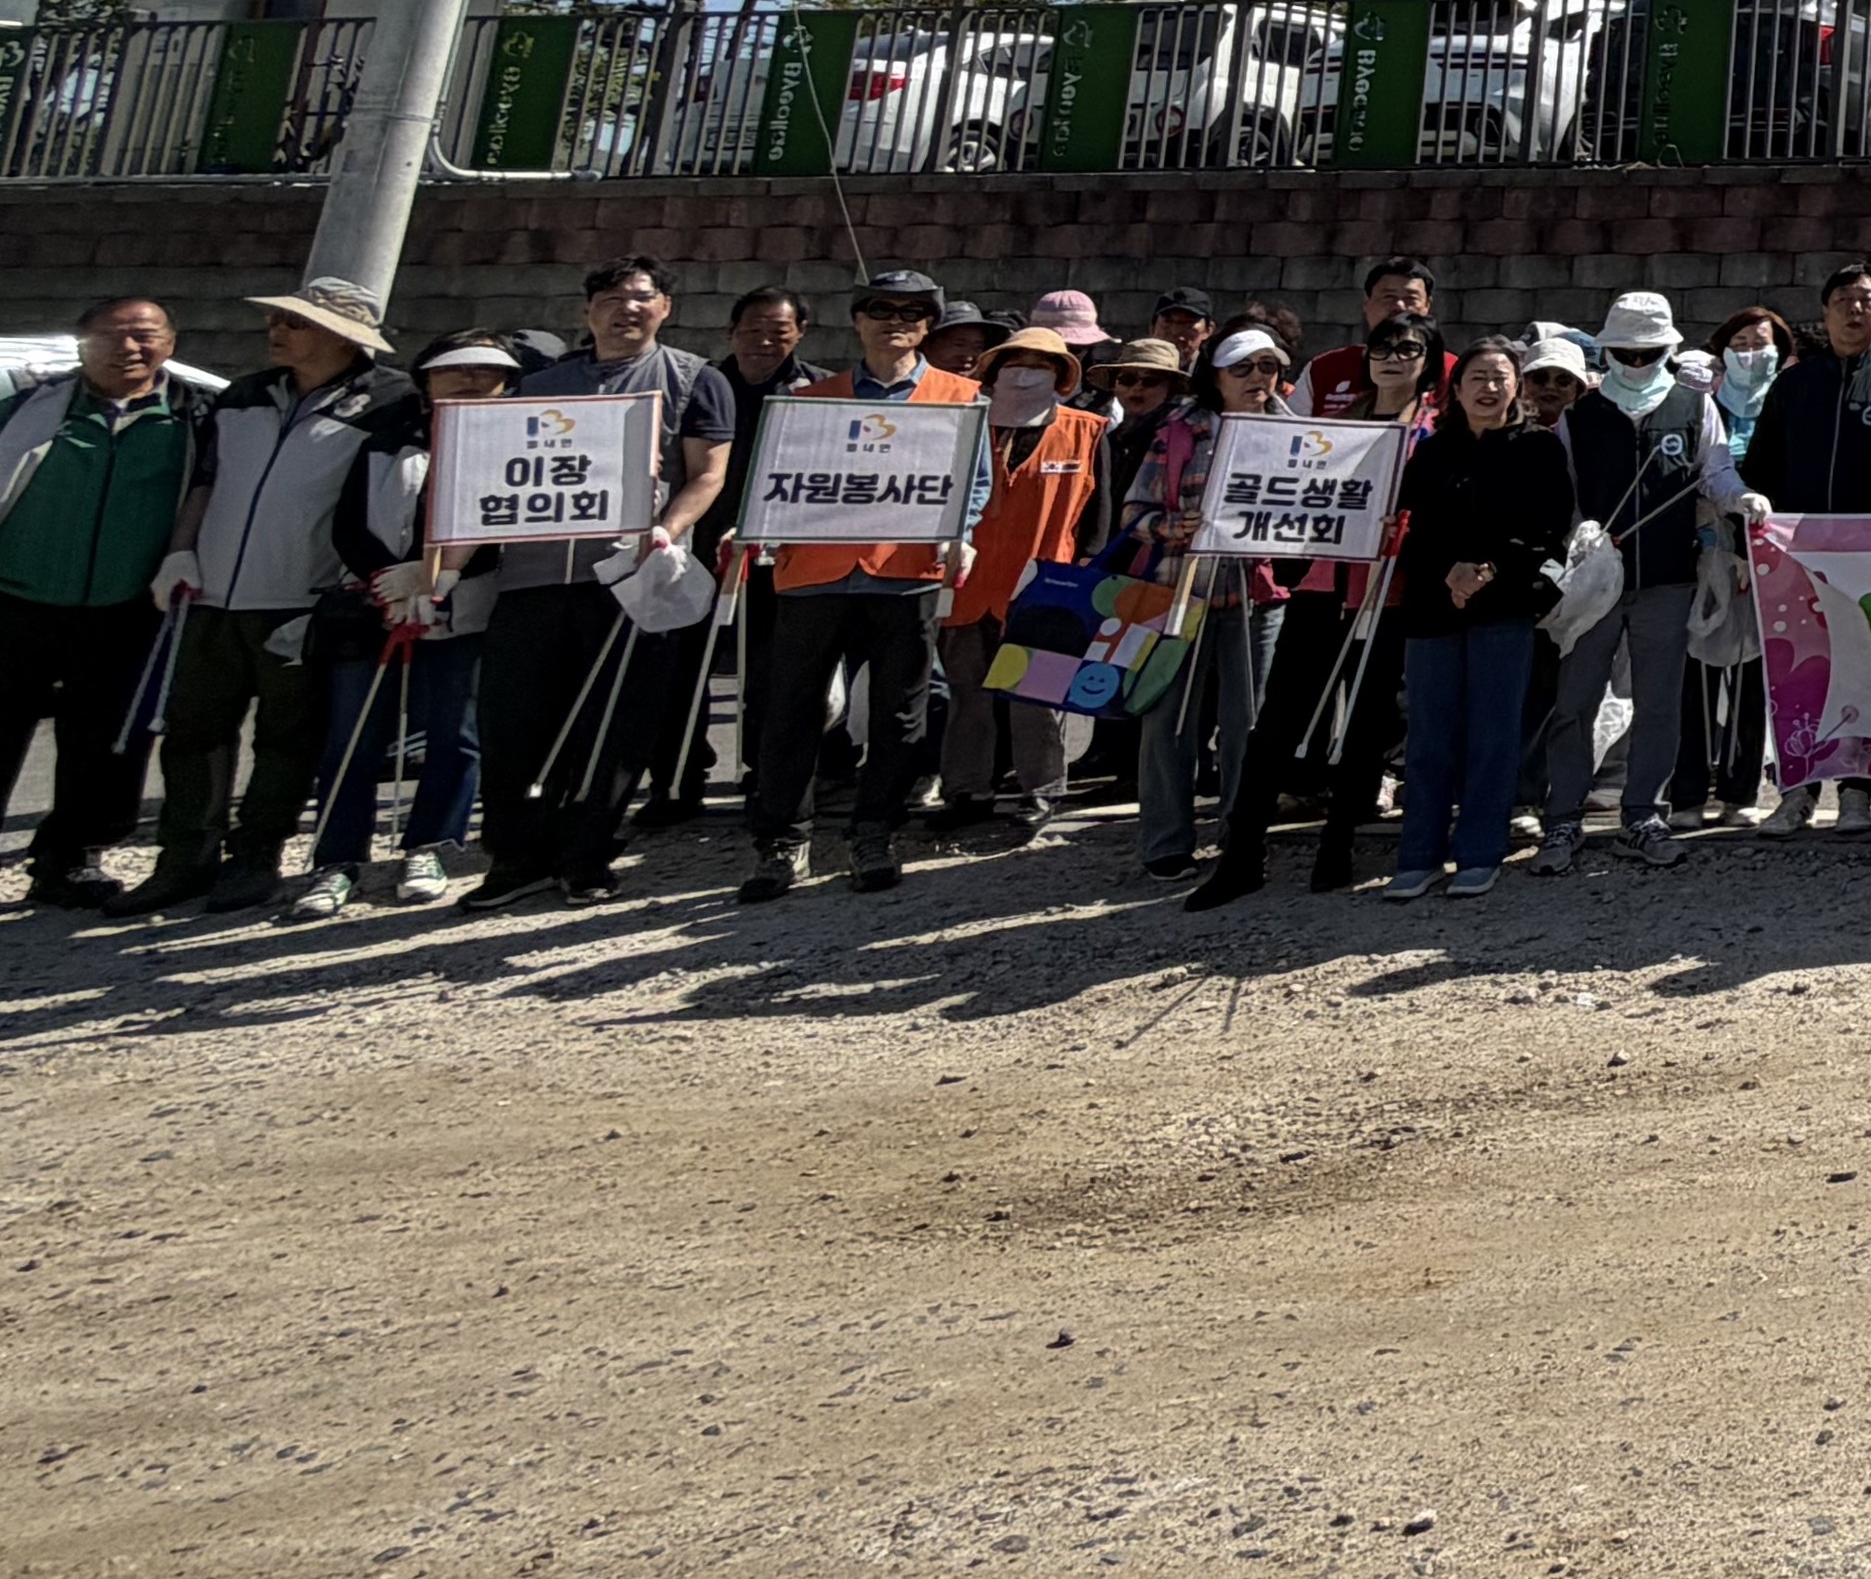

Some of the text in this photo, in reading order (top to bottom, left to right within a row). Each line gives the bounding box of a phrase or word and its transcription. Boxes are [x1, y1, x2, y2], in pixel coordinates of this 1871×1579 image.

[505, 455, 591, 488] 이장
[765, 472, 953, 505] 자원봉사단
[1223, 472, 1373, 510] 골드생활
[478, 489, 609, 526] 협의회
[1233, 512, 1346, 545] 개선회
